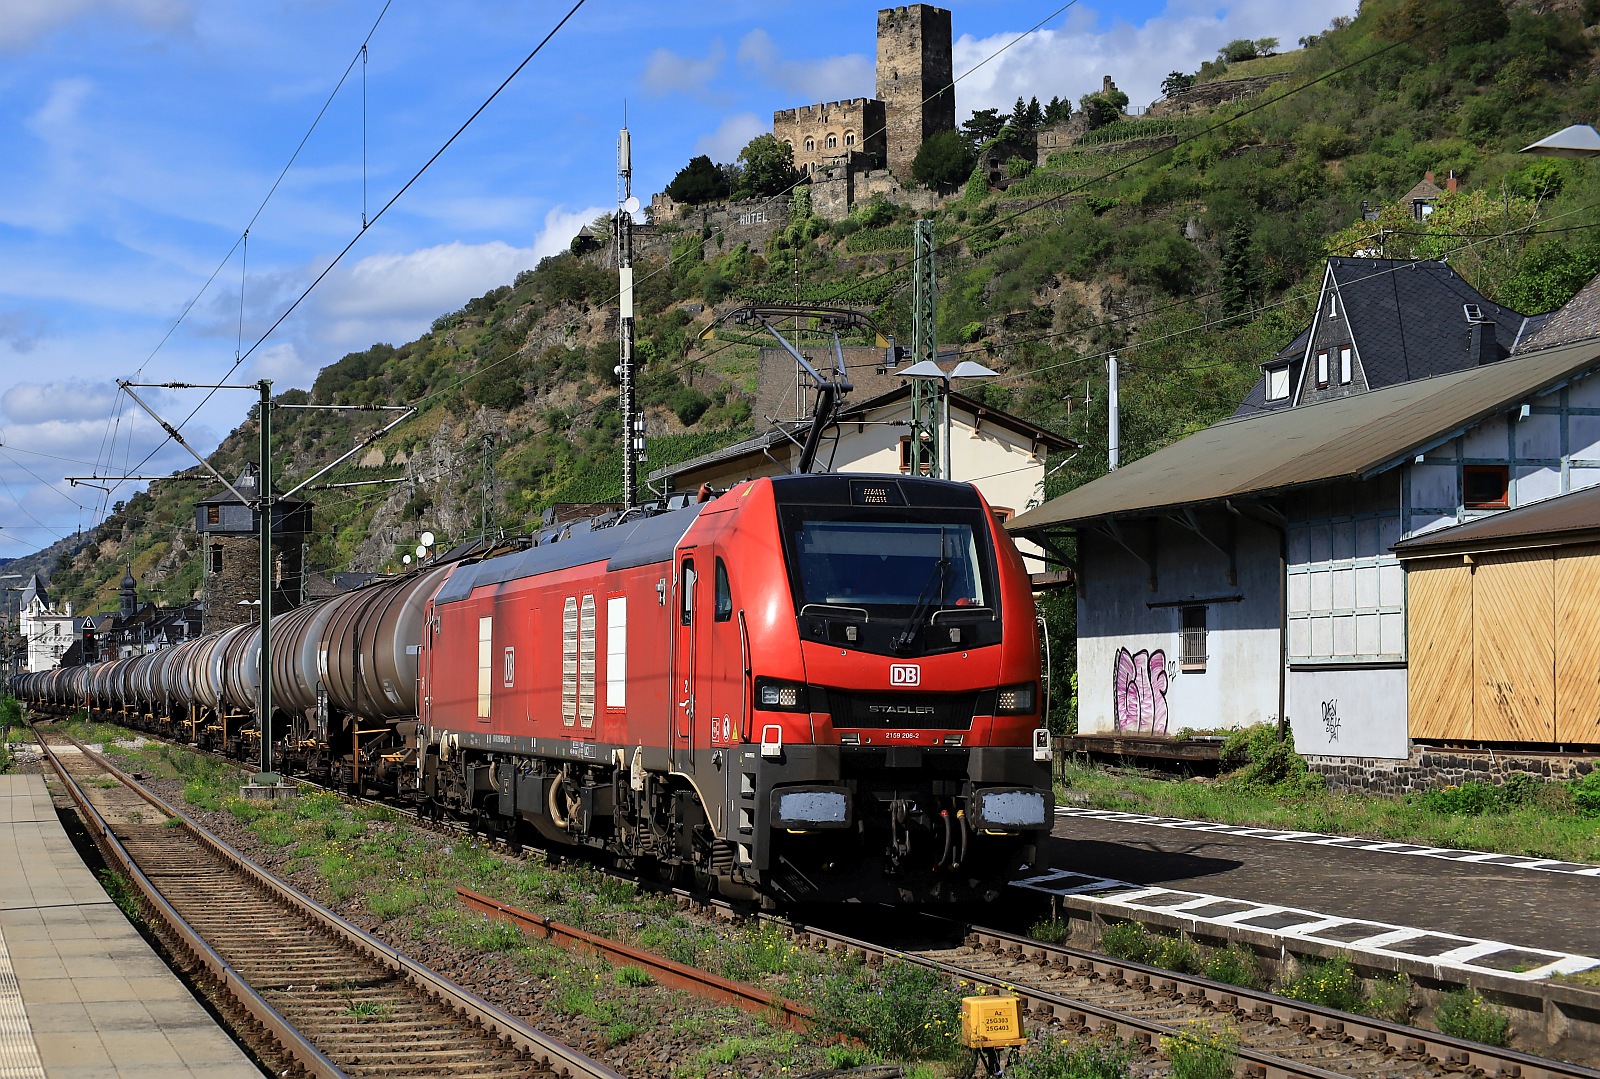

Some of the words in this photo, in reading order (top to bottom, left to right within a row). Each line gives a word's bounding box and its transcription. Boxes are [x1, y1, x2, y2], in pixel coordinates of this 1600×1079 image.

[505, 652, 513, 681] DB
[892, 666, 918, 684] DB
[869, 705, 935, 714] STADLER
